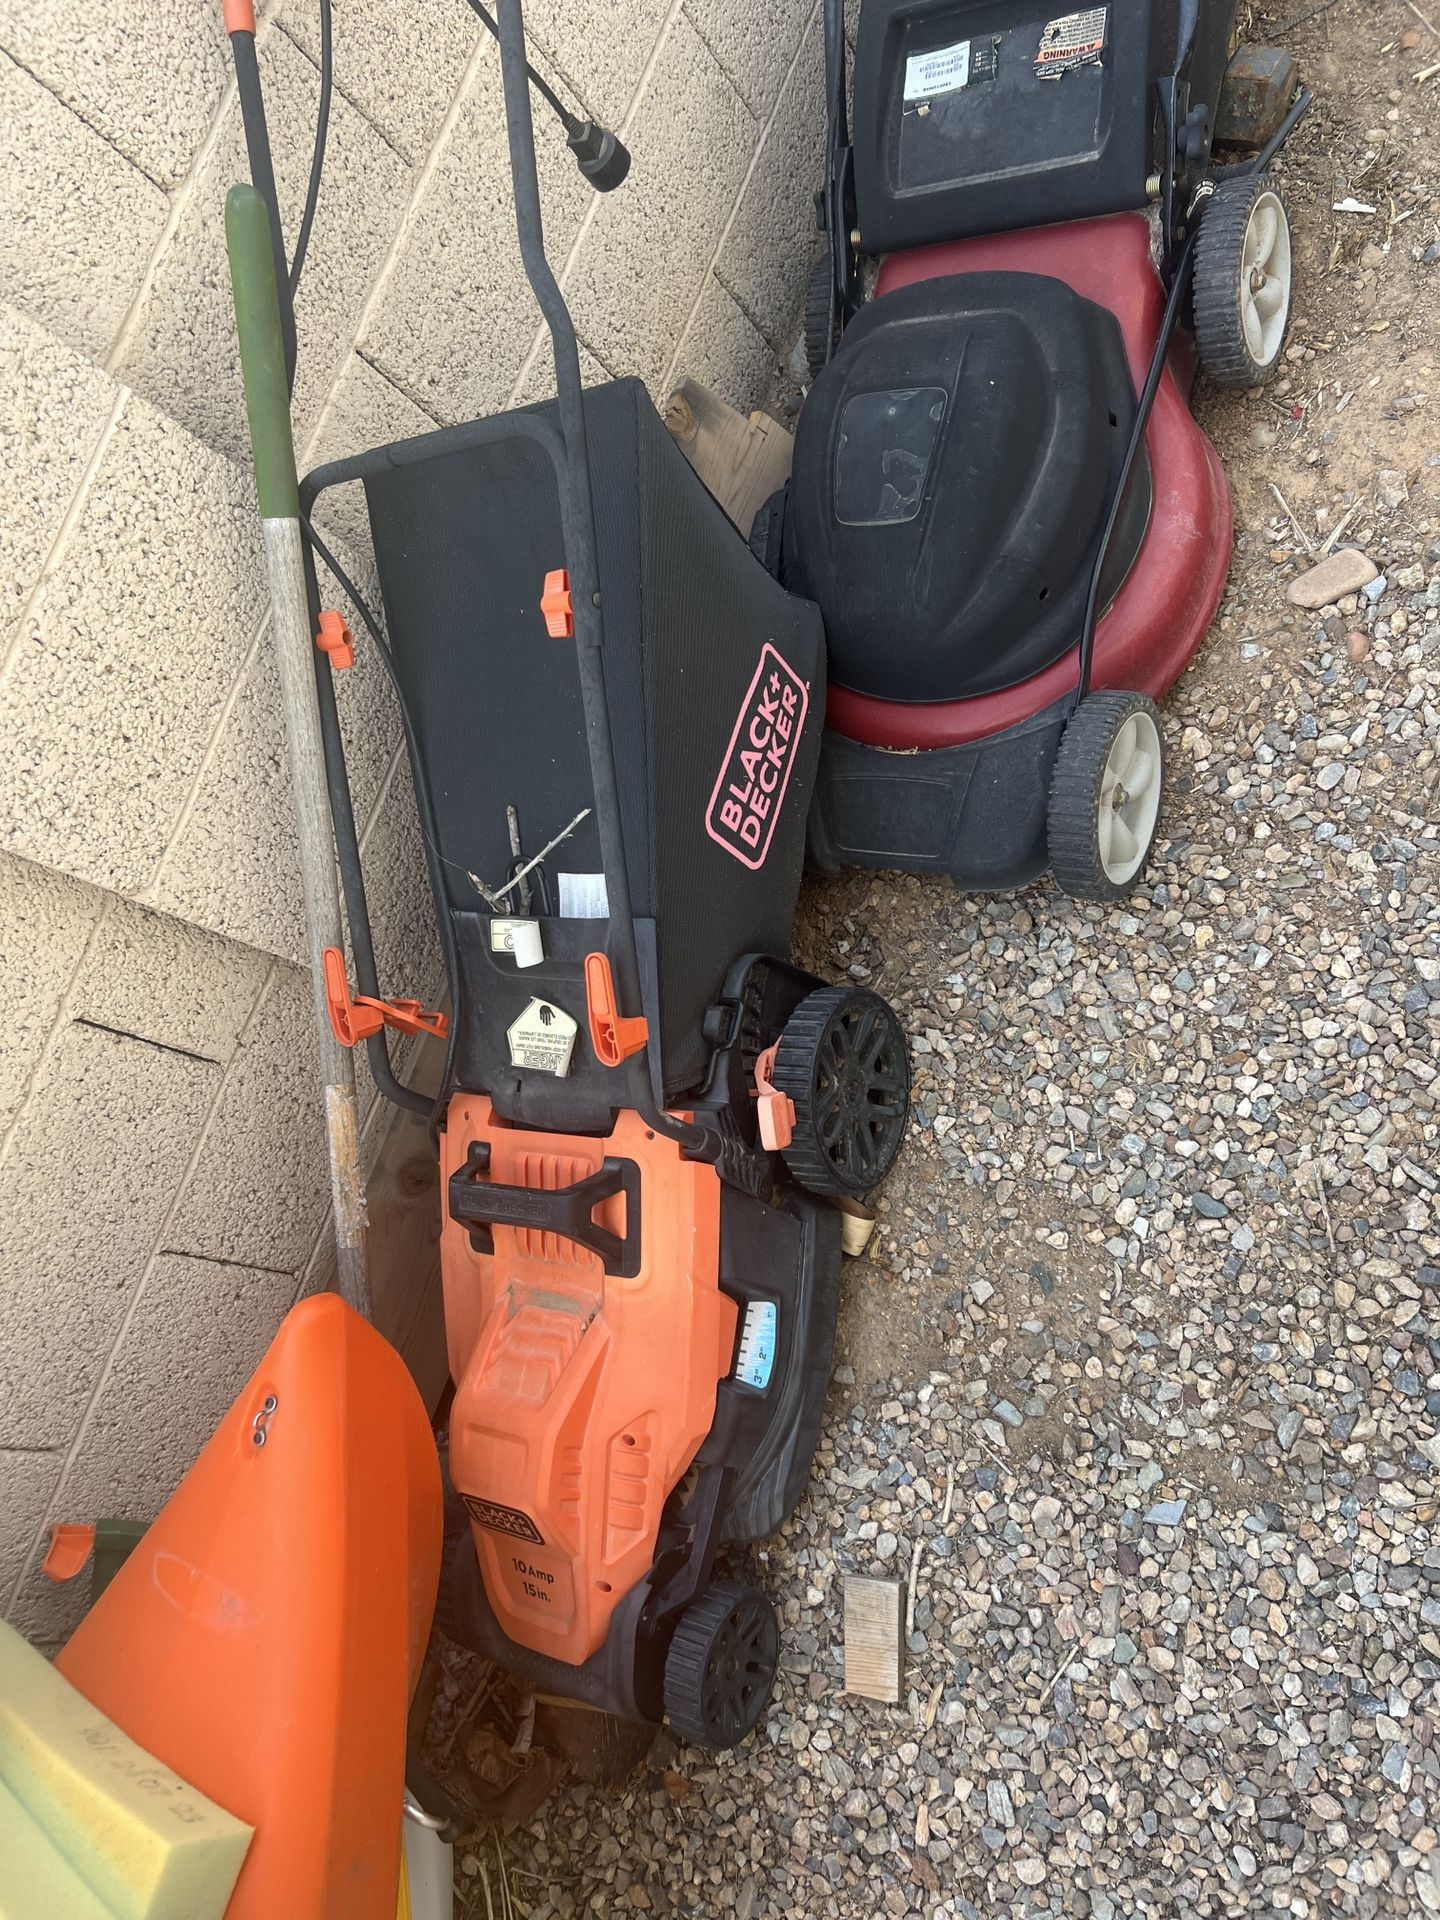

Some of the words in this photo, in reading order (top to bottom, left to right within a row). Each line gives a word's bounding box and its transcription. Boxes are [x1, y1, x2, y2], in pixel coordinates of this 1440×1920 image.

[1044, 46, 1085, 60] WARNING
[720, 671, 781, 832] BLACK+
[740, 684, 798, 848] DECKER
[759, 1347, 767, 1360] 2"
[754, 1369, 763, 1384] 3"
[470, 1502, 525, 1525] BLACK+
[477, 1512, 533, 1538] DECKER
